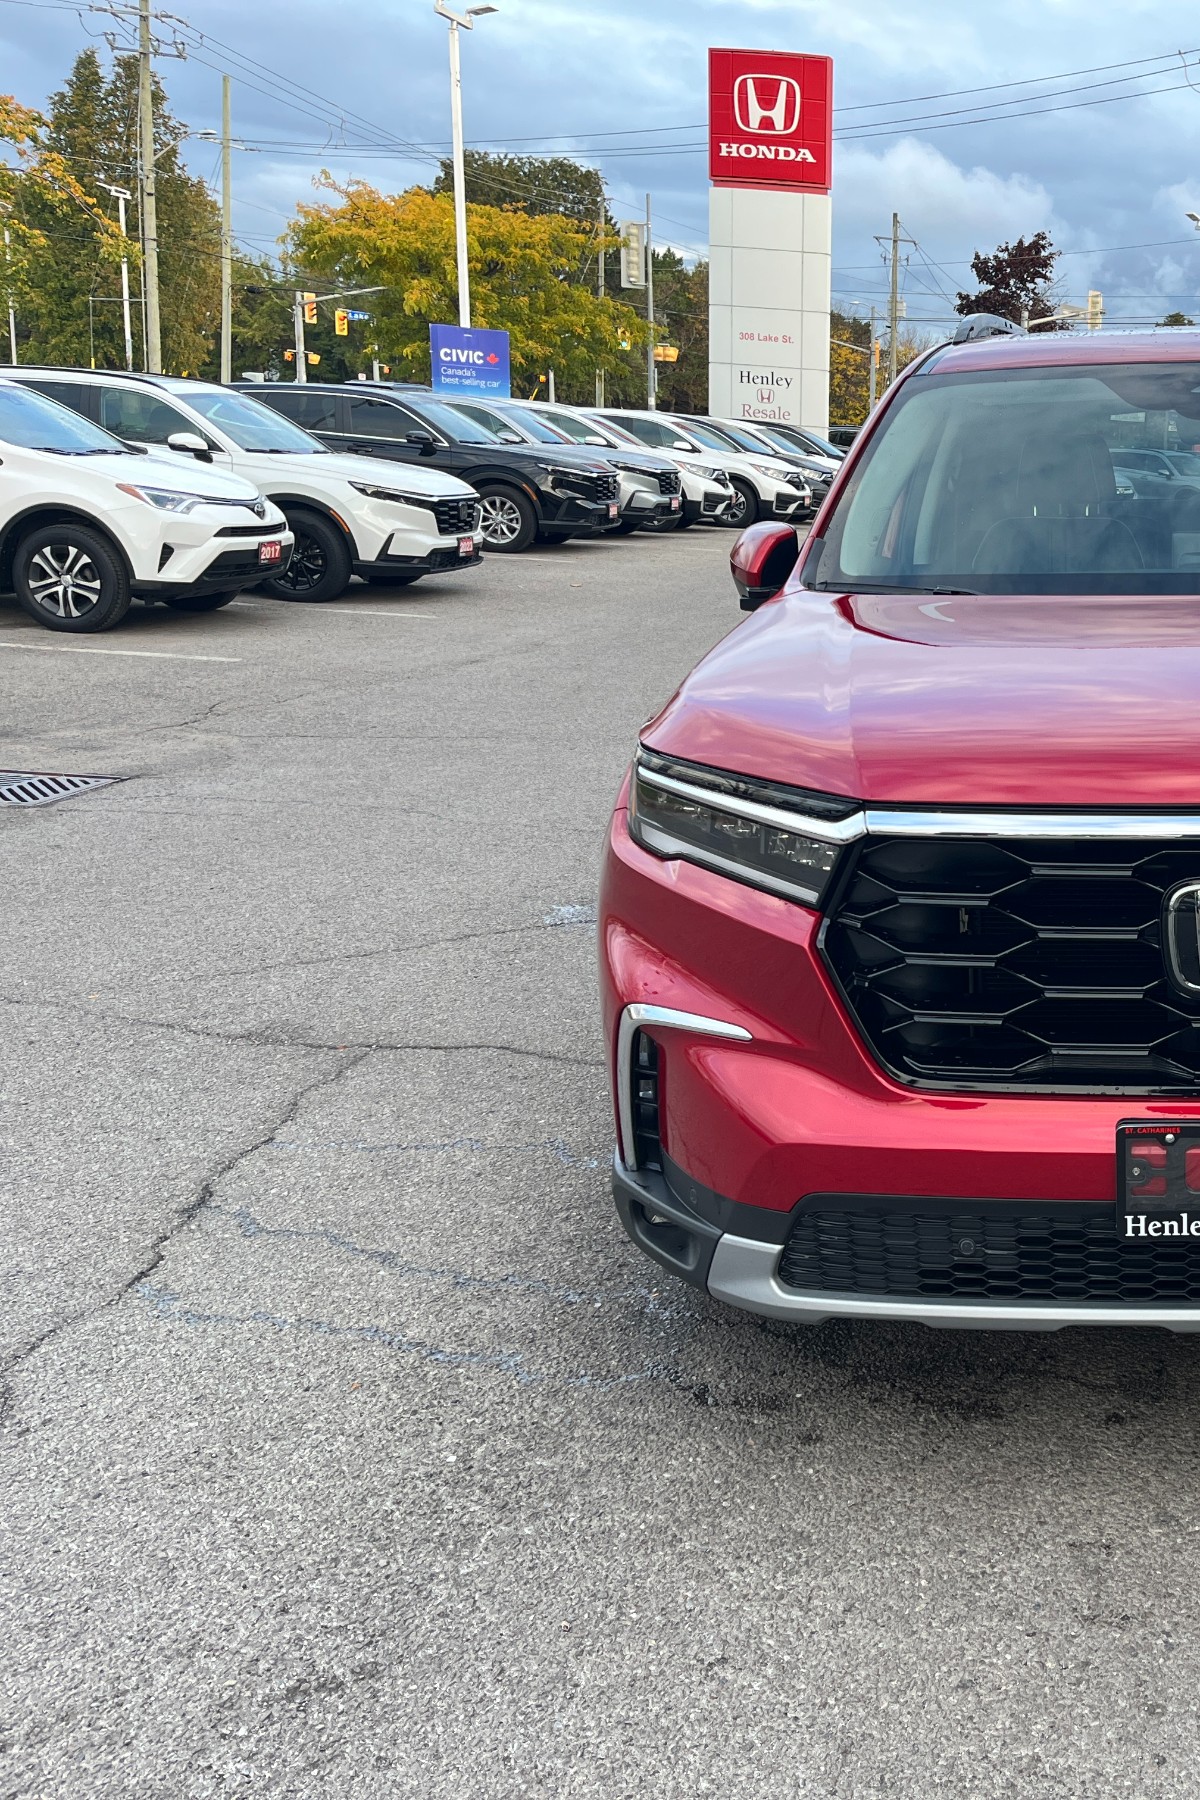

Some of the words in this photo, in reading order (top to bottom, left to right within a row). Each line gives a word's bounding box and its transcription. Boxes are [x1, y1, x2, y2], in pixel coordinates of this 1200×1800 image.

[719, 143, 816, 163] HONDA
[739, 332, 755, 341] 308
[757, 333, 779, 342] Lake
[781, 335, 794, 344] St.
[440, 348, 484, 364] CIVIC
[441, 366, 476, 377] Canada's
[441, 376, 485, 388] best-selling
[739, 370, 793, 389] Henley
[741, 403, 791, 420] Resale
[261, 546, 280, 559] 2017
